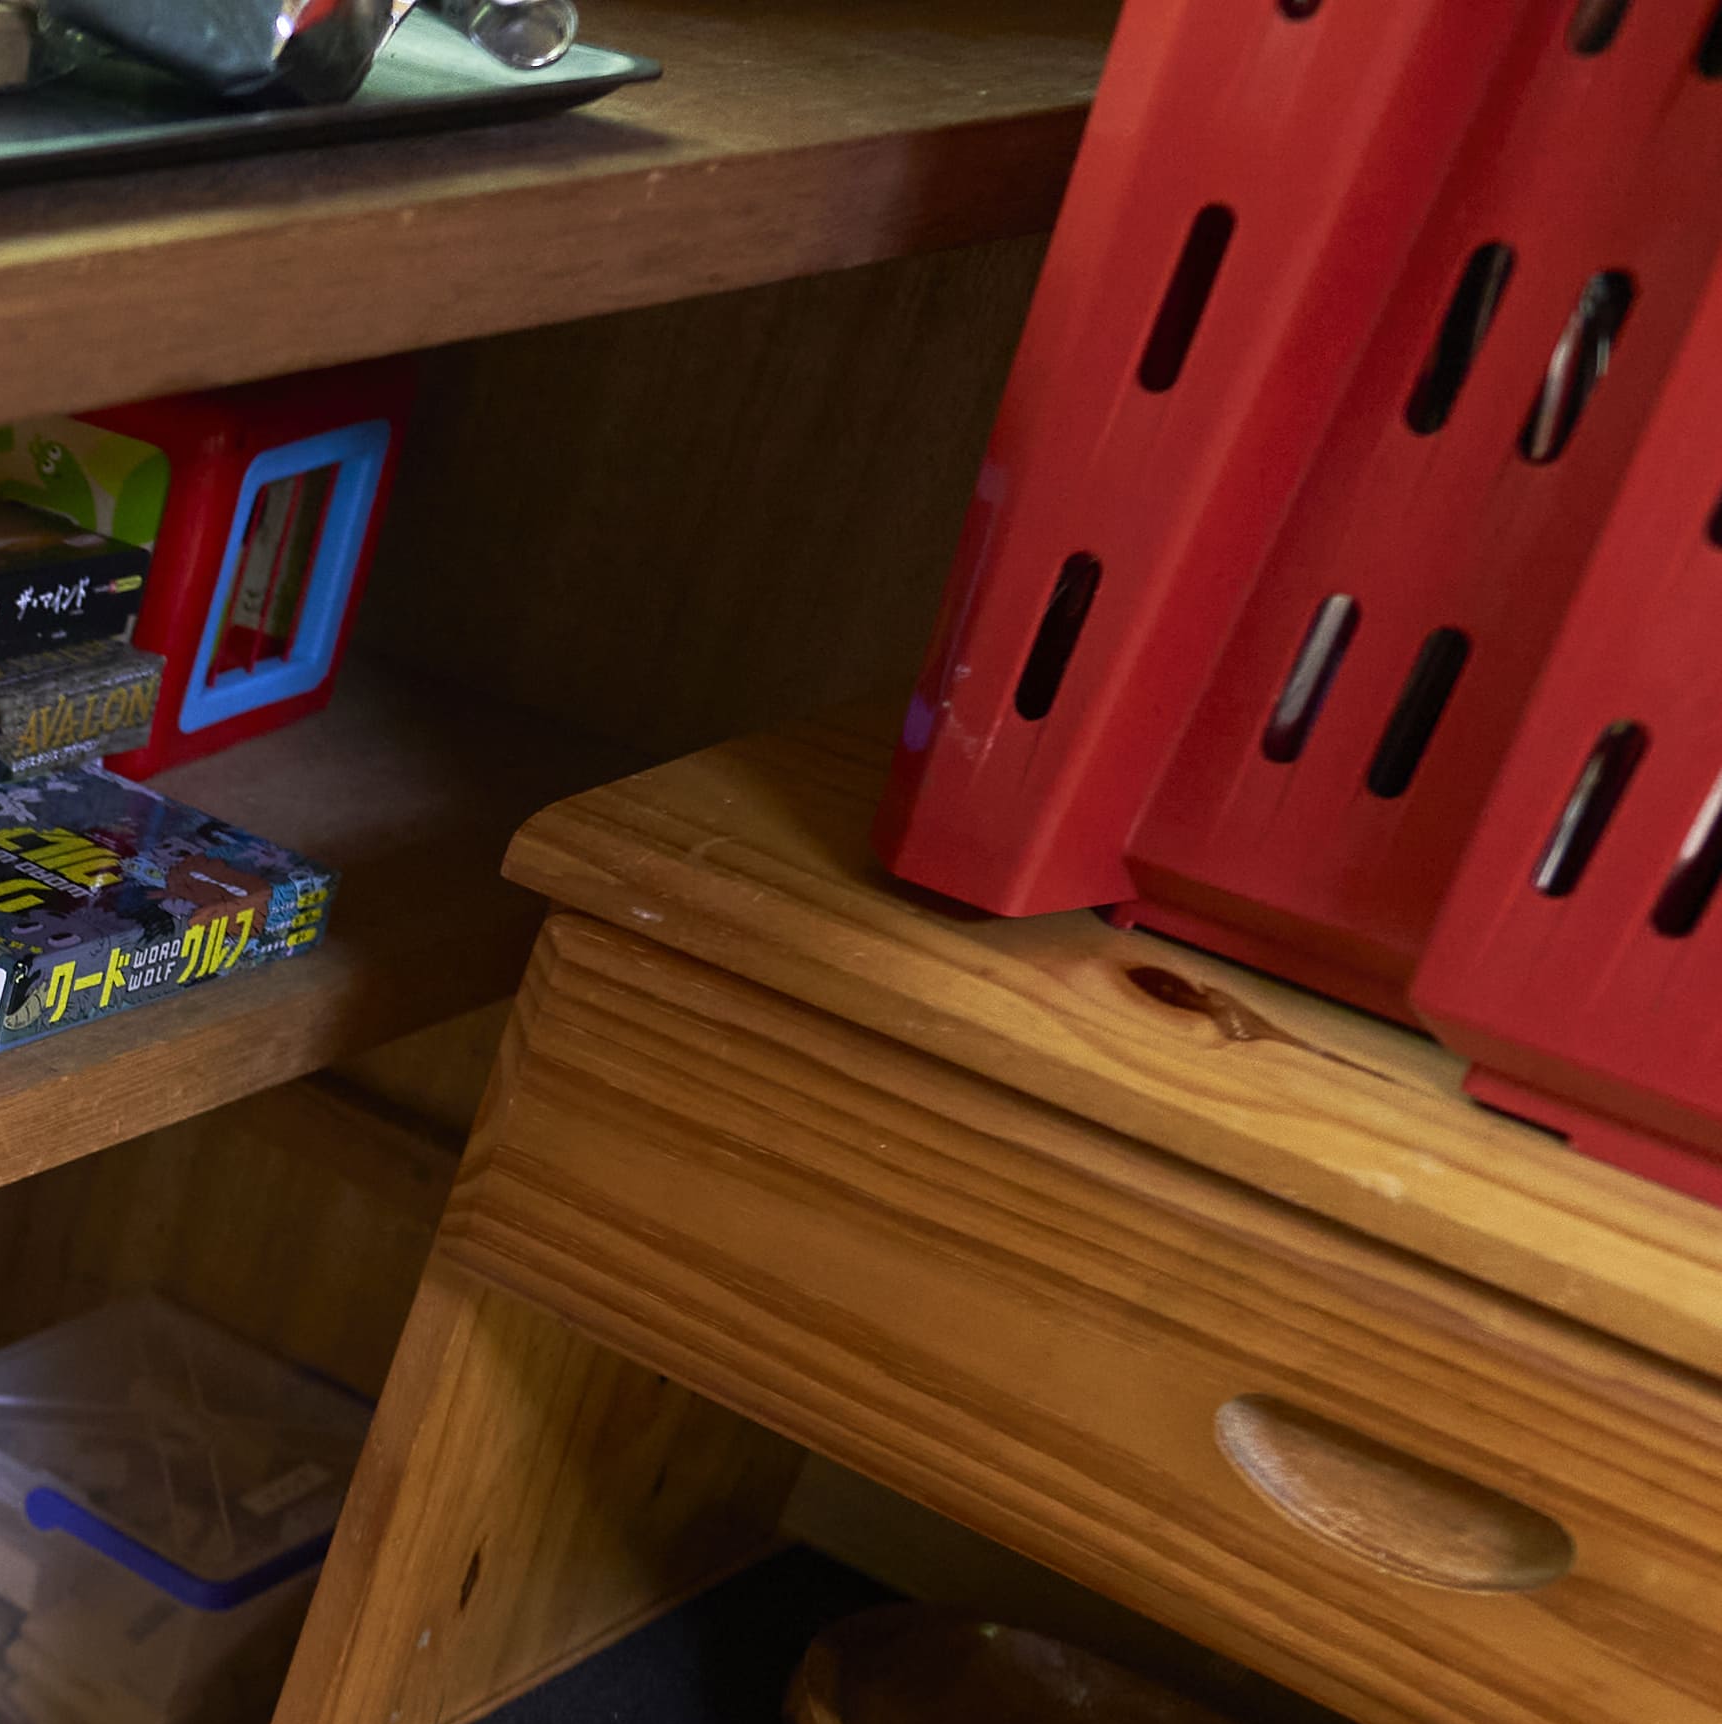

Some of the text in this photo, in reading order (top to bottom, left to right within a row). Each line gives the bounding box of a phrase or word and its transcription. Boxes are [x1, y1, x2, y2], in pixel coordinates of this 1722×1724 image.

[16, 677, 155, 759] AVALON
[17, 858, 91, 898] WORD
[131, 939, 183, 970] WORD
[179, 908, 258, 985] ウルフ
[45, 946, 131, 1024] ワード
[127, 960, 176, 992] WOLF
